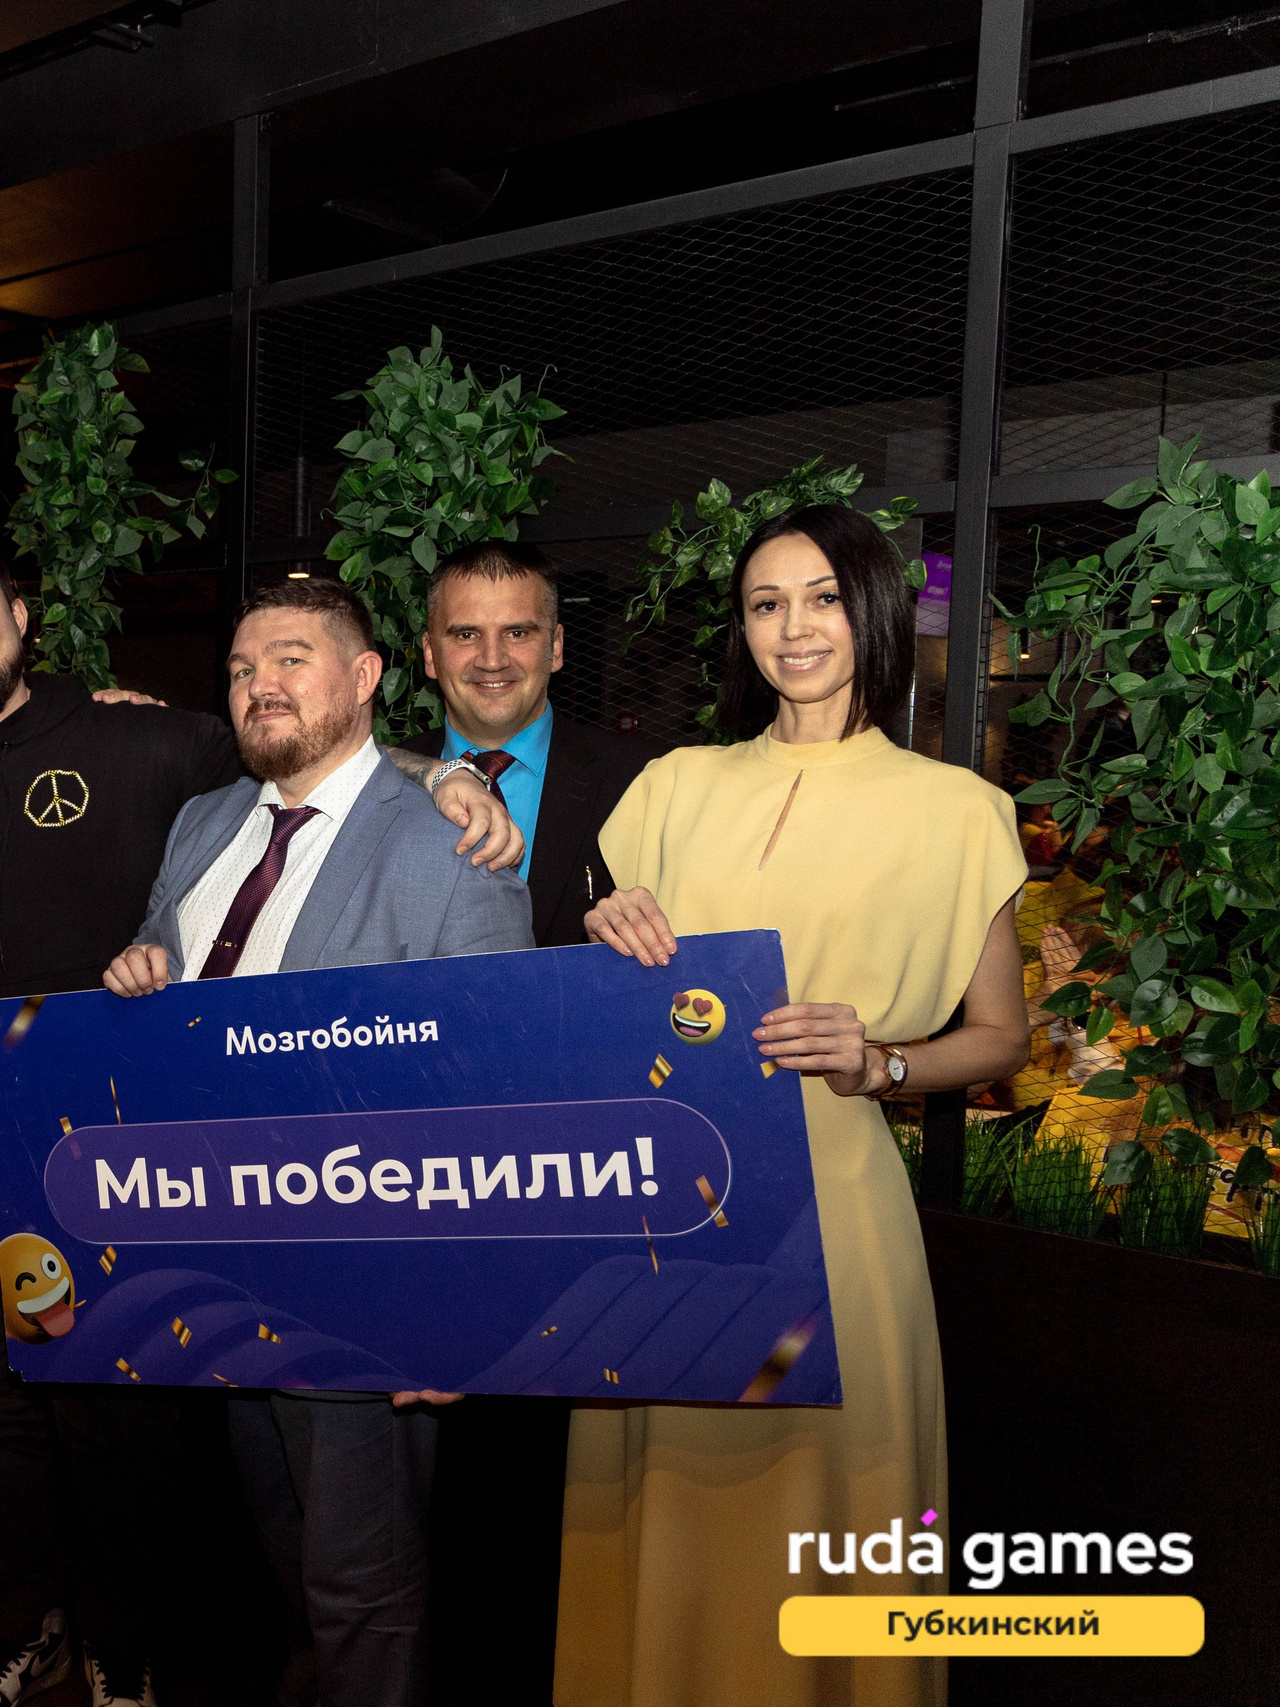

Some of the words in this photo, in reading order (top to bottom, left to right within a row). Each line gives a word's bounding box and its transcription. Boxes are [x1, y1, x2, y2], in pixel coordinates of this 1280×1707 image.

[226, 1015, 439, 1056] Мозгобойня
[95, 1157, 207, 1210] Мы
[230, 1137, 660, 1210] победили!
